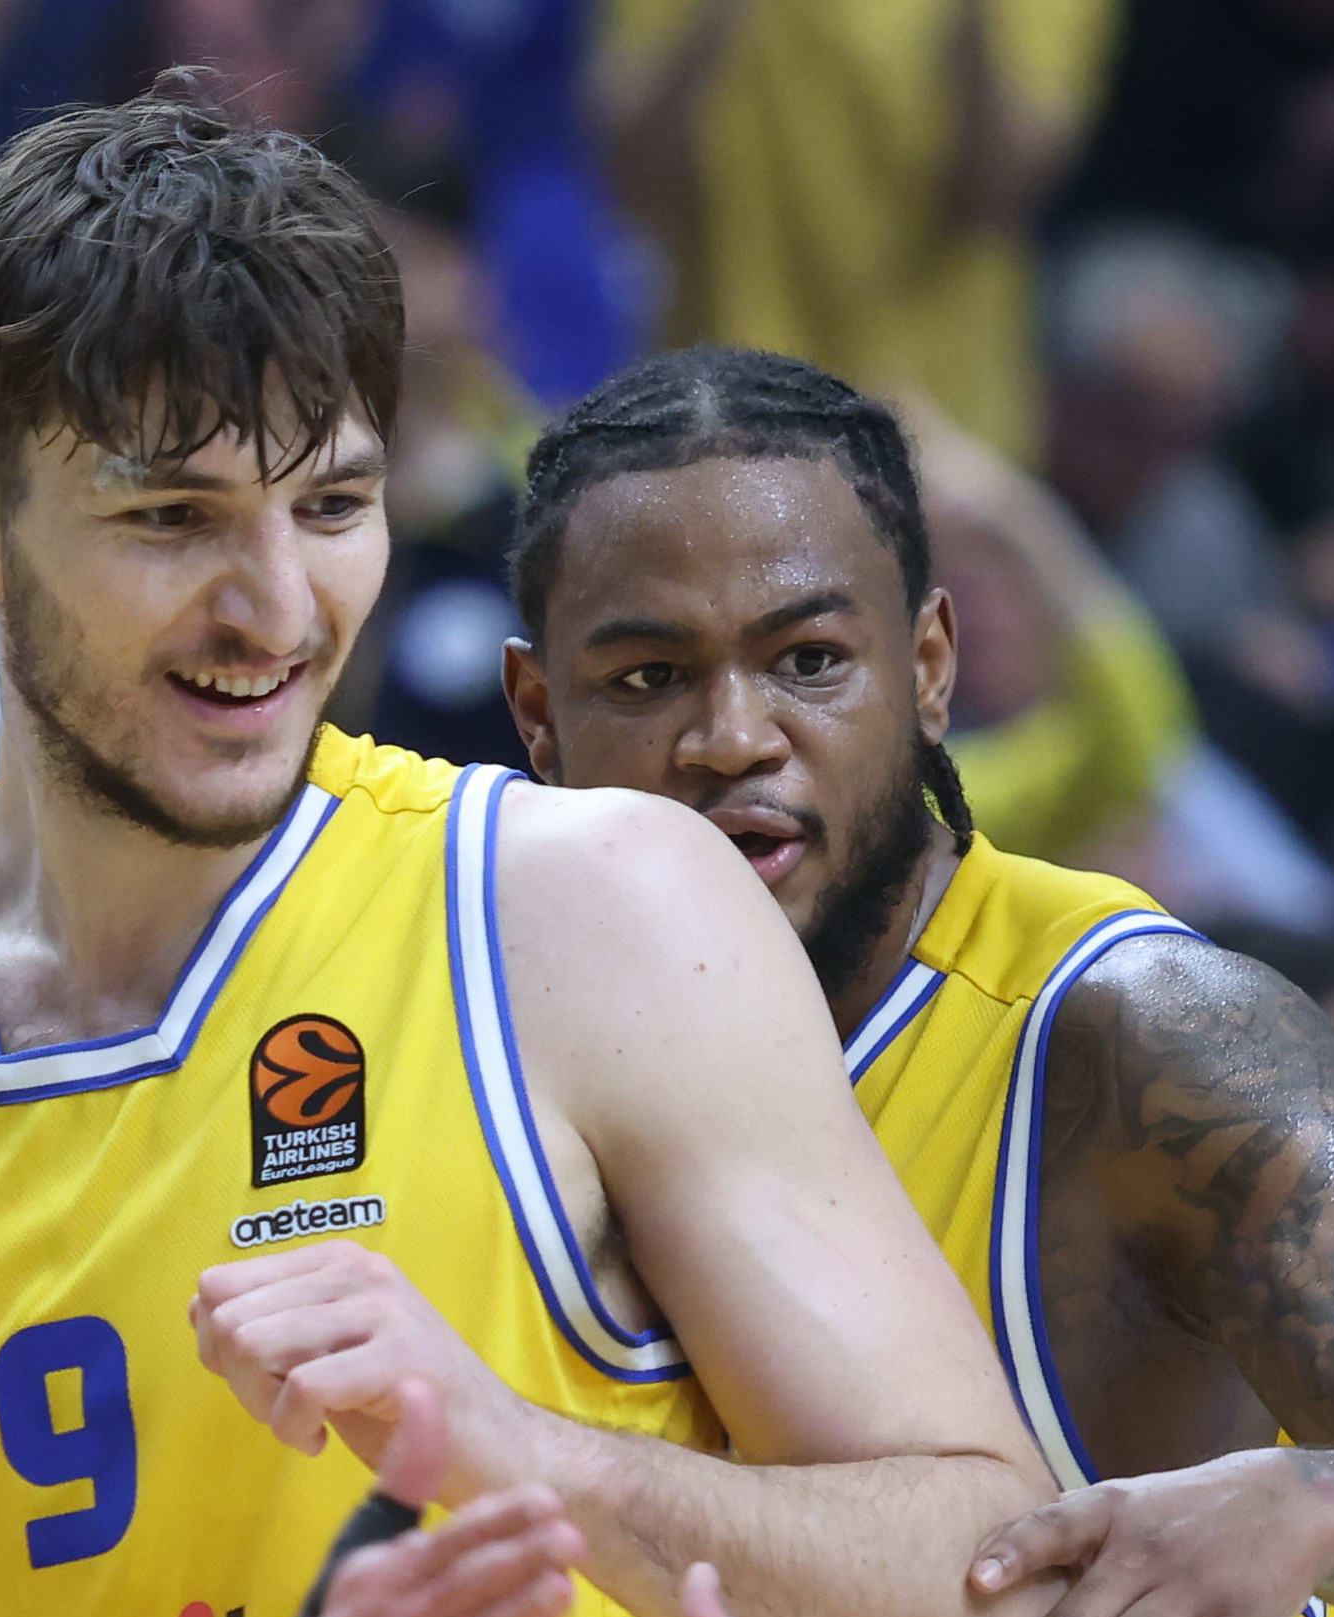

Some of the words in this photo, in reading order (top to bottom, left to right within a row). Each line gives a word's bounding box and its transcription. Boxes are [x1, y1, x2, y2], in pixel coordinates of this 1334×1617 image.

[263, 1121, 357, 1151] TURKISH
[263, 1138, 357, 1168] AIRLINES
[260, 1157, 355, 1181] EuroLeague
[235, 1198, 383, 1243] oneteam
